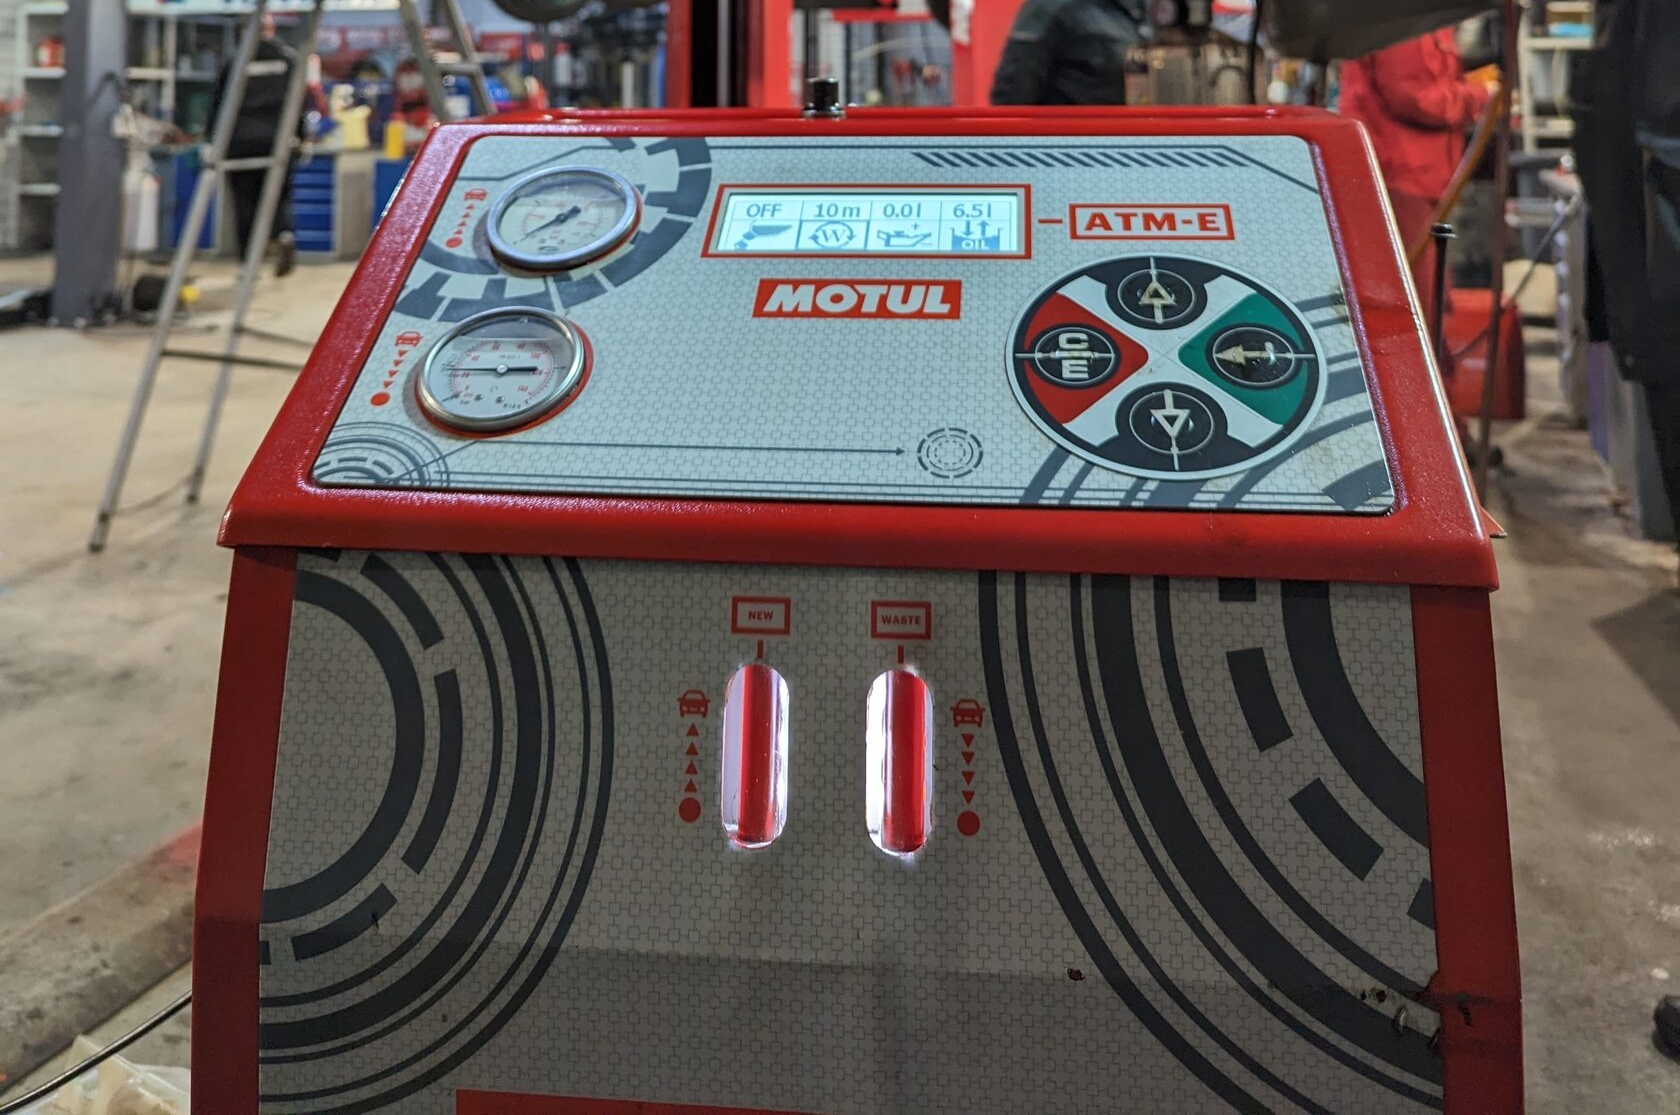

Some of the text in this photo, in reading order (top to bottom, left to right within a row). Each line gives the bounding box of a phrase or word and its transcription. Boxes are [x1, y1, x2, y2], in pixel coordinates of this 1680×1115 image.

[746, 203, 782, 218] OFF
[1084, 211, 1220, 232] ATM-E
[961, 238, 990, 249] OIL
[762, 284, 951, 314] MOTUL
[748, 610, 774, 621] NEW
[881, 614, 922, 626] WASTE
